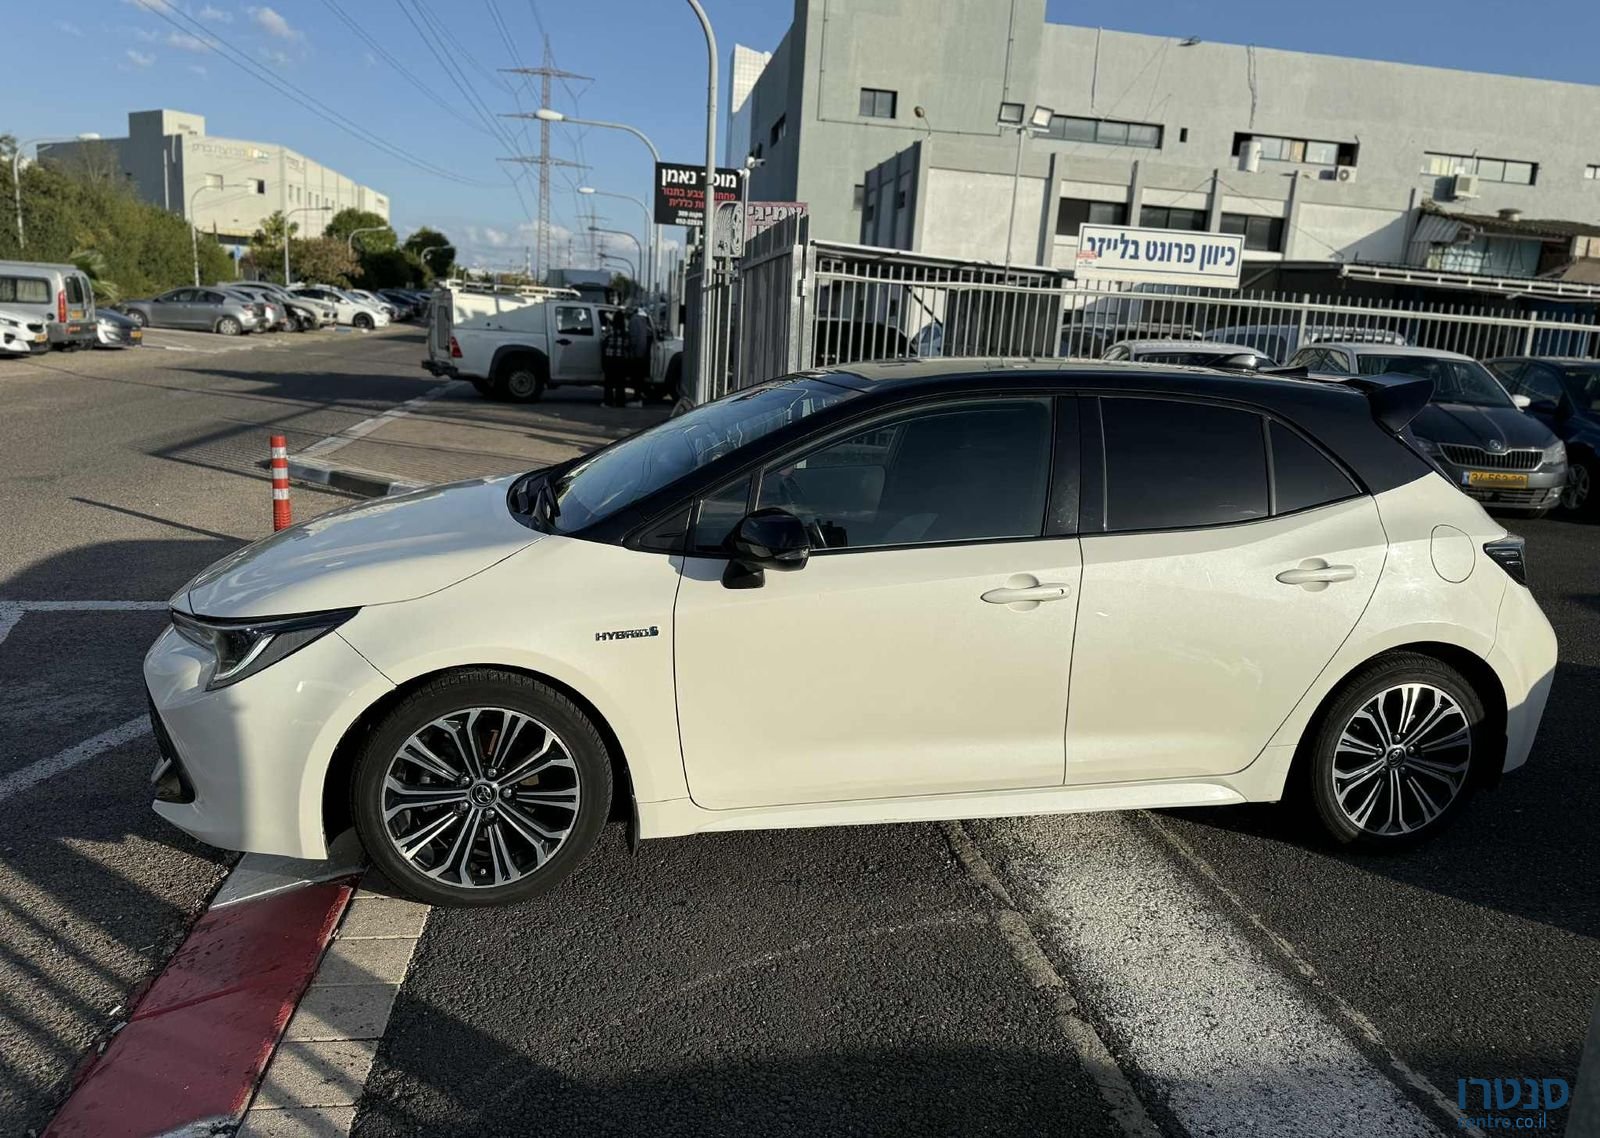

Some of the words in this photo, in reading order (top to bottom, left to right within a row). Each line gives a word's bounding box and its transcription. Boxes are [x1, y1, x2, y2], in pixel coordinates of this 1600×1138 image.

[661, 168, 697, 186] נאמן
[701, 172, 737, 188] מוס
[1087, 232, 1140, 260] בלייזר
[1145, 240, 1196, 263] פרונט
[1198, 243, 1236, 271] כיוון
[595, 628, 649, 641] HYBRID
